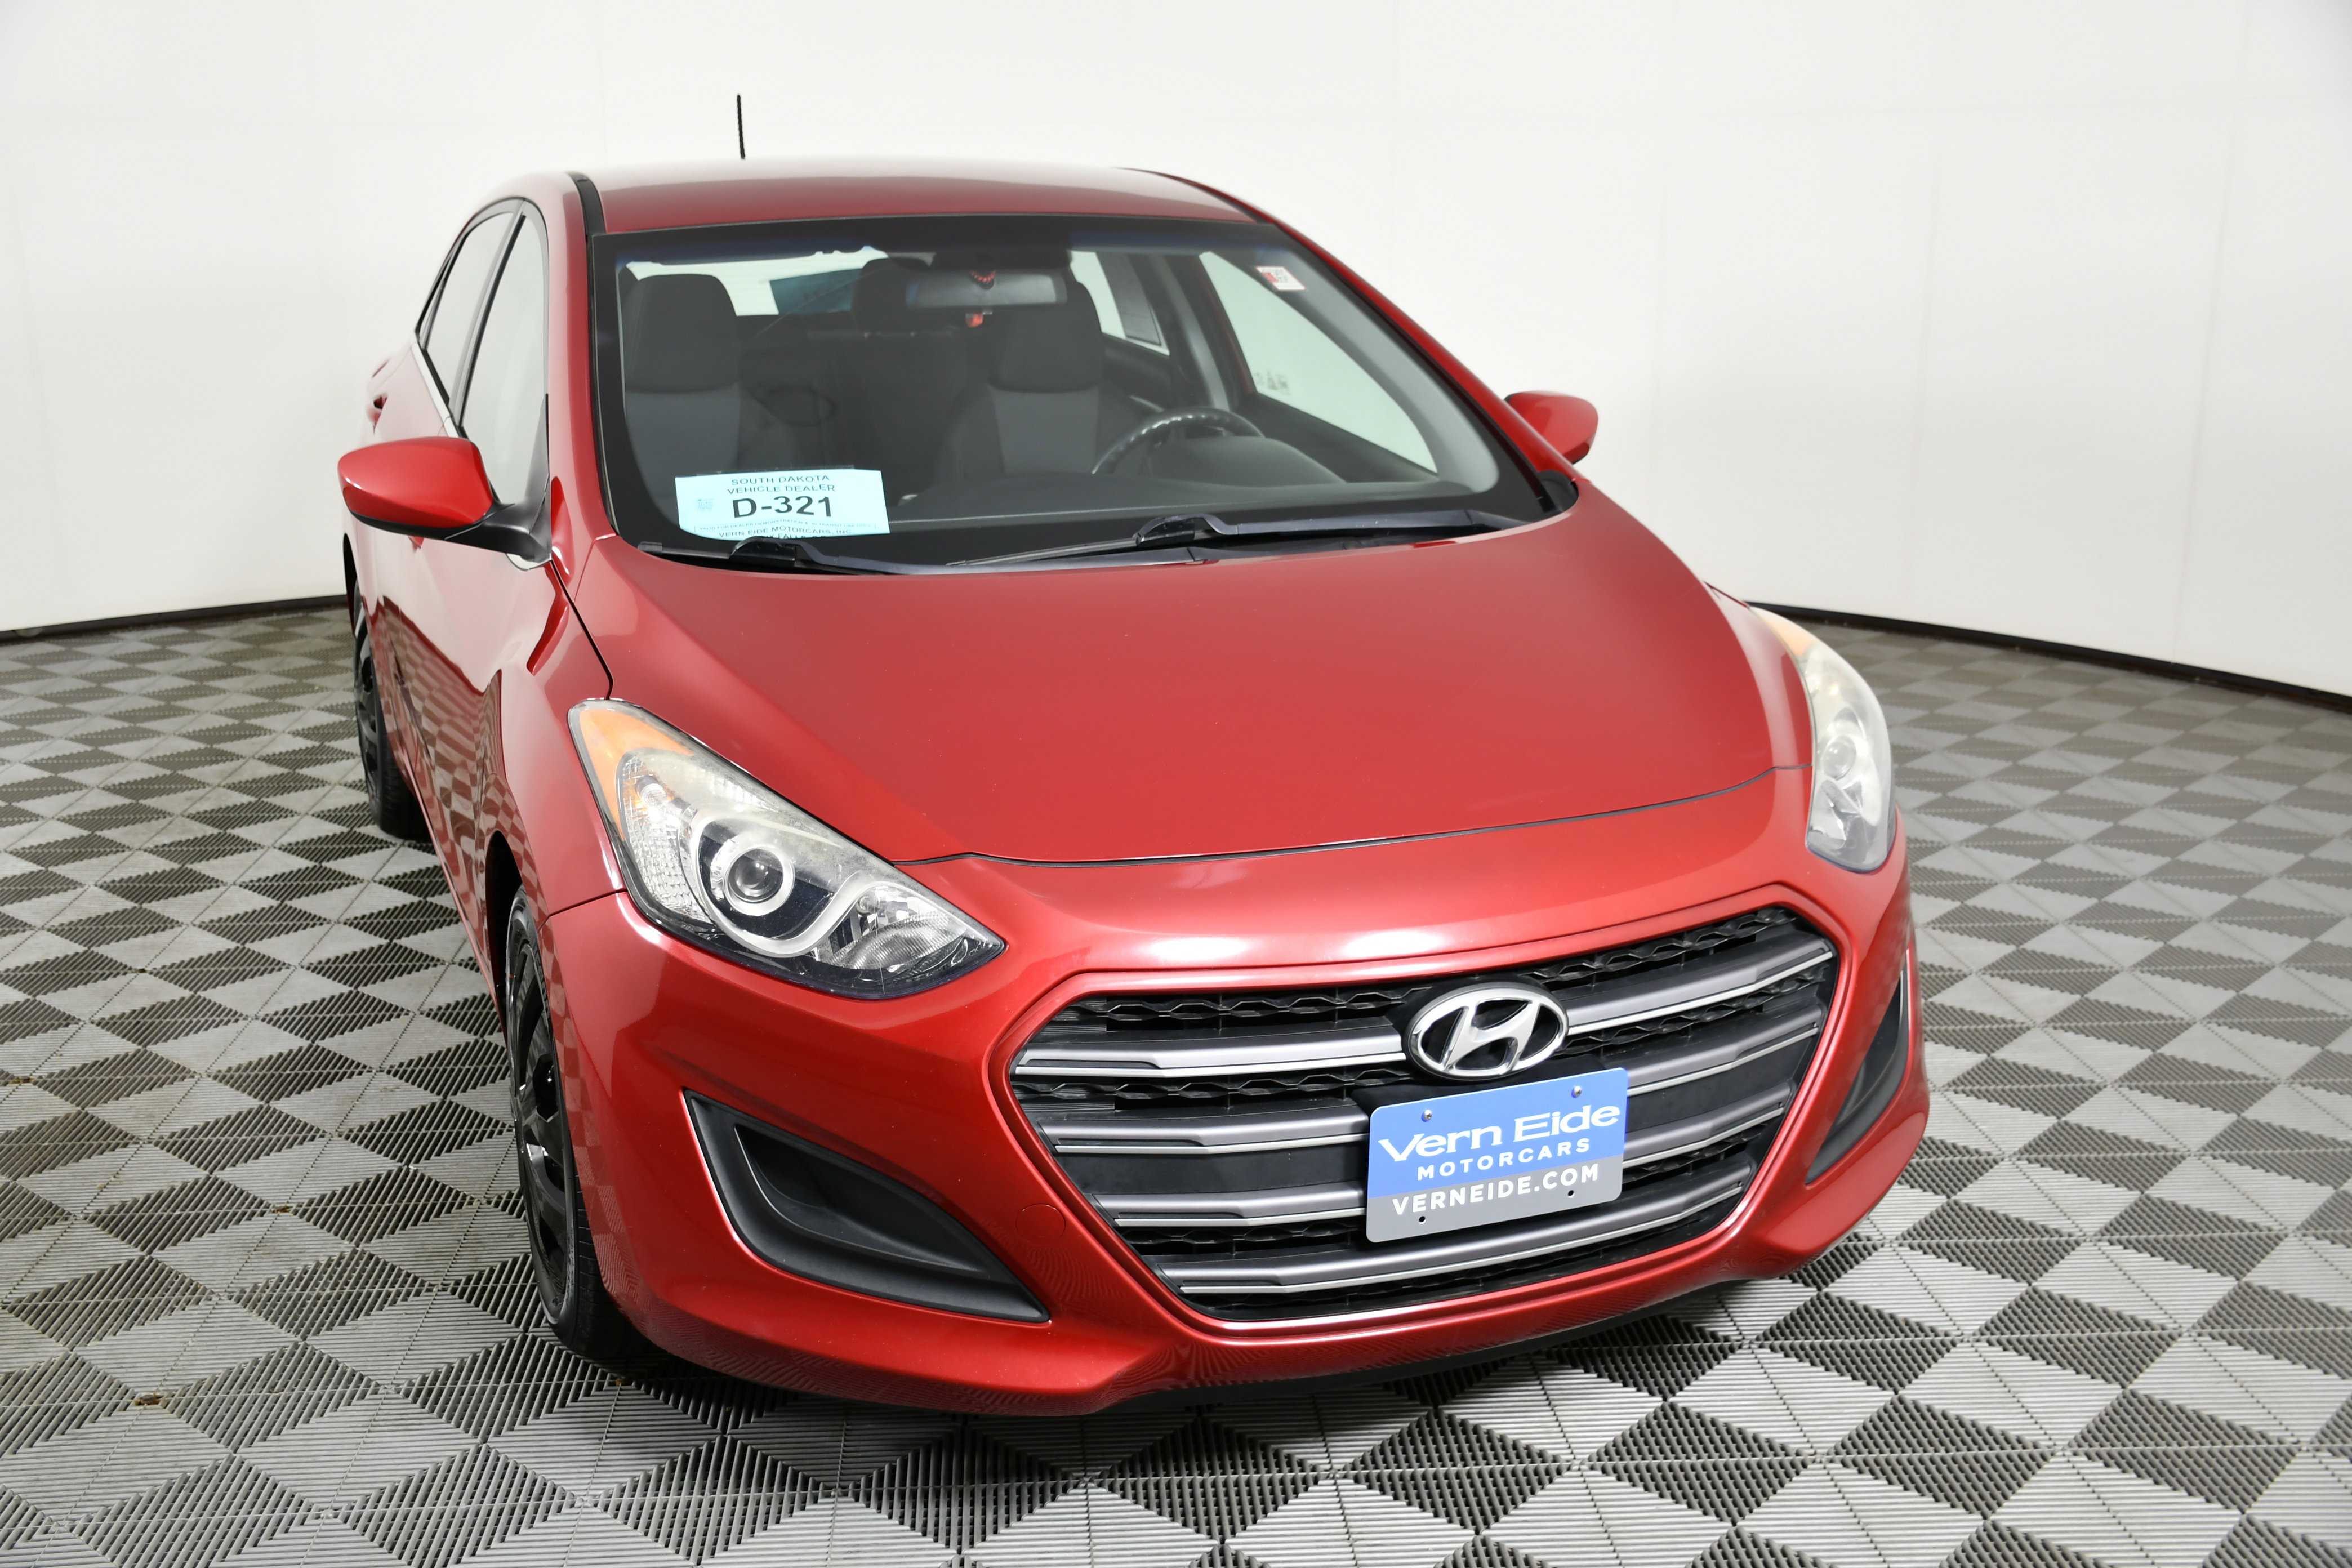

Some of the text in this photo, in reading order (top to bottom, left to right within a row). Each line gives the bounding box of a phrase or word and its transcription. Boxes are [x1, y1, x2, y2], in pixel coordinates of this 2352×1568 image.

[727, 484, 835, 495] VEHICLE DEALER
[732, 477, 774, 485] SOUTH
[733, 496, 831, 518] D-321
[772, 525, 834, 534] MOTORCARS,
[1378, 1104, 1620, 1162] Vern Eide
[1417, 1138, 1590, 1181] MOTORCARS
[1392, 1163, 1598, 1216] VERNEIDE.COM
